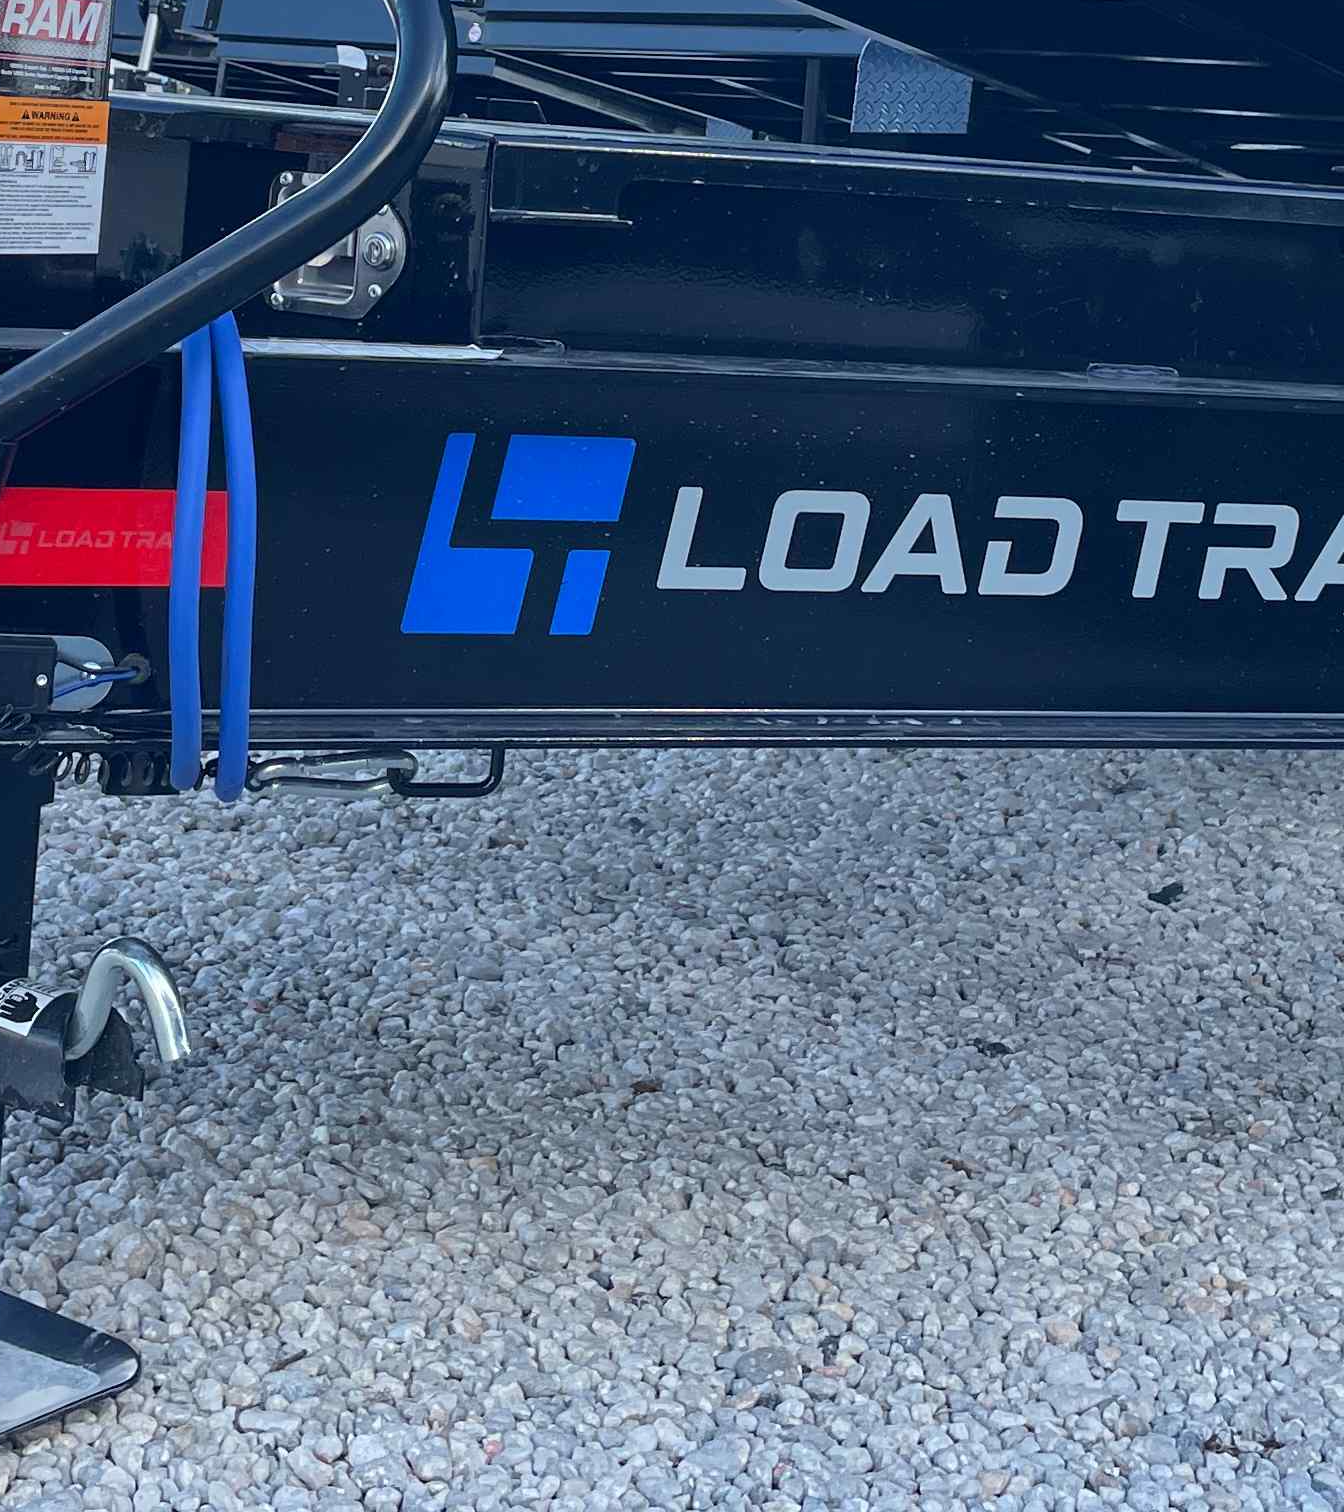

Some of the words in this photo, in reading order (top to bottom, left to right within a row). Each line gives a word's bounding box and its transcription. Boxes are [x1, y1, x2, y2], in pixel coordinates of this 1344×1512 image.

[32, 110, 71, 121] WARNING
[37, 530, 118, 548] LOAD
[120, 529, 173, 550] TRA
[656, 485, 1084, 597] LOAD
